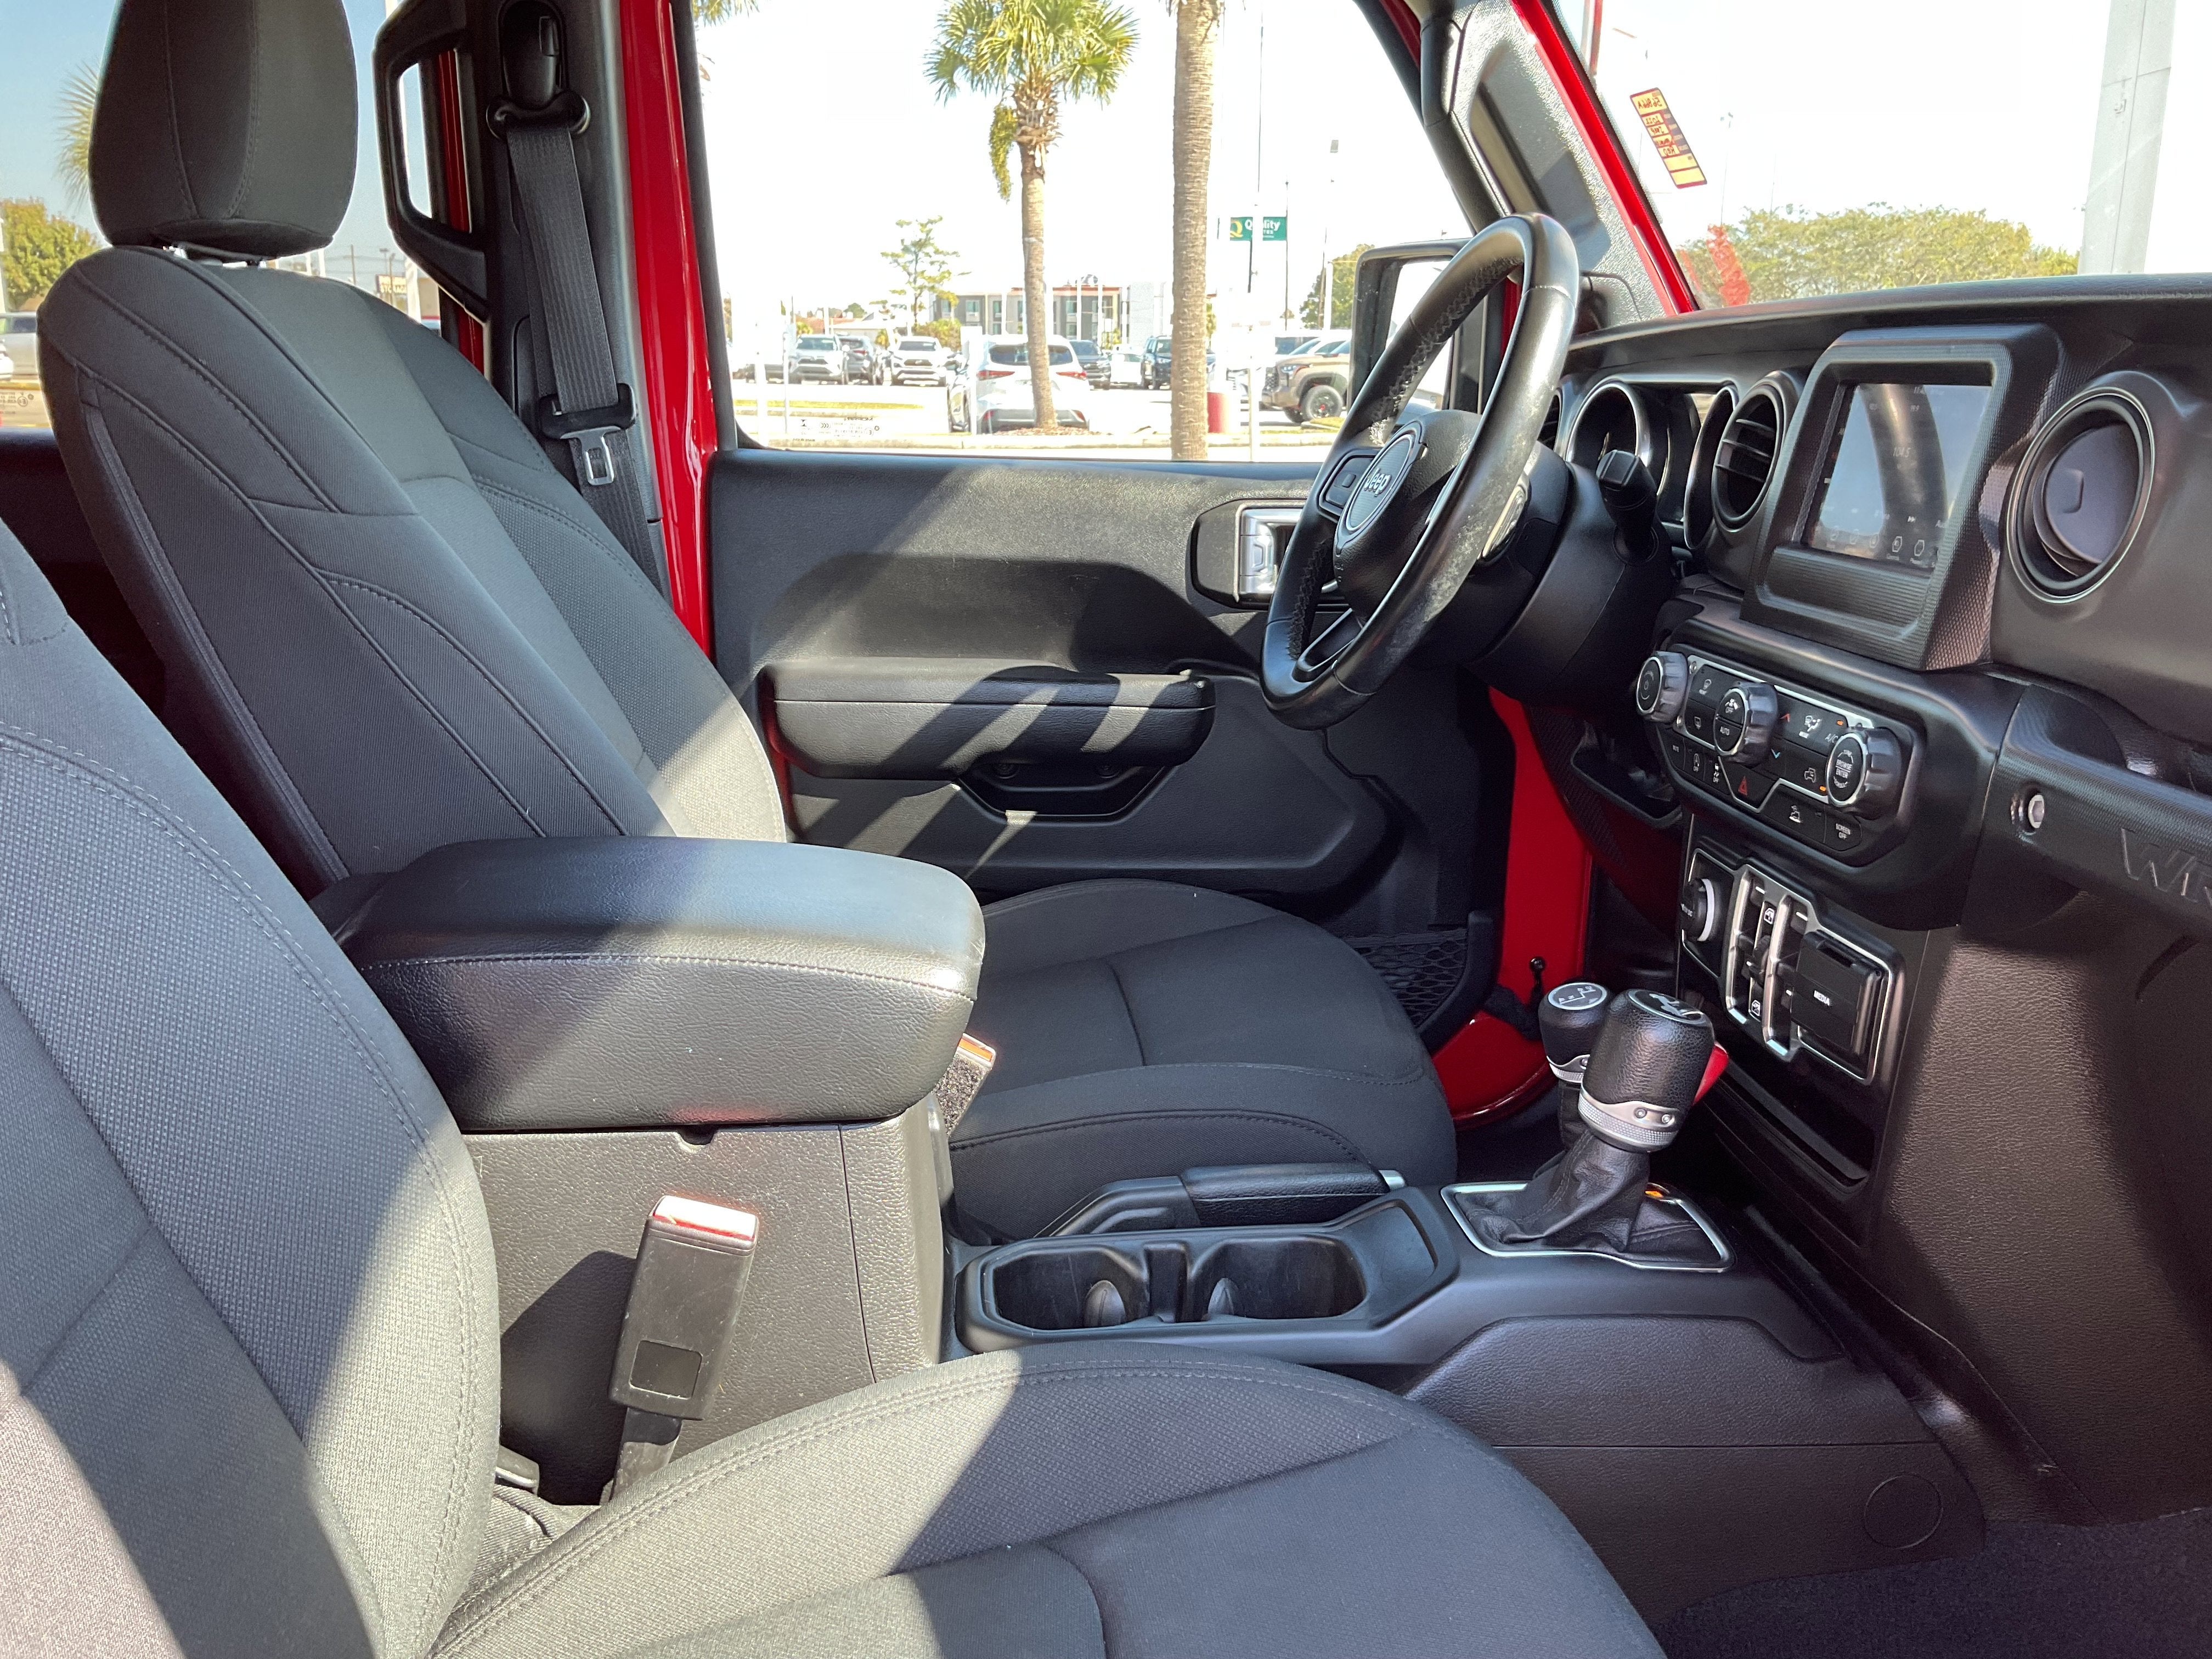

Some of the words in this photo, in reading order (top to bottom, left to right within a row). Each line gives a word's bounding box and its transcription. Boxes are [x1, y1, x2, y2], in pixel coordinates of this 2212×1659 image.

[1244, 219, 1280, 231] Qlity
[1364, 468, 1391, 495] Jeep
[1825, 733, 1838, 743] A/C
[1813, 990, 1830, 1006] MEDIA
